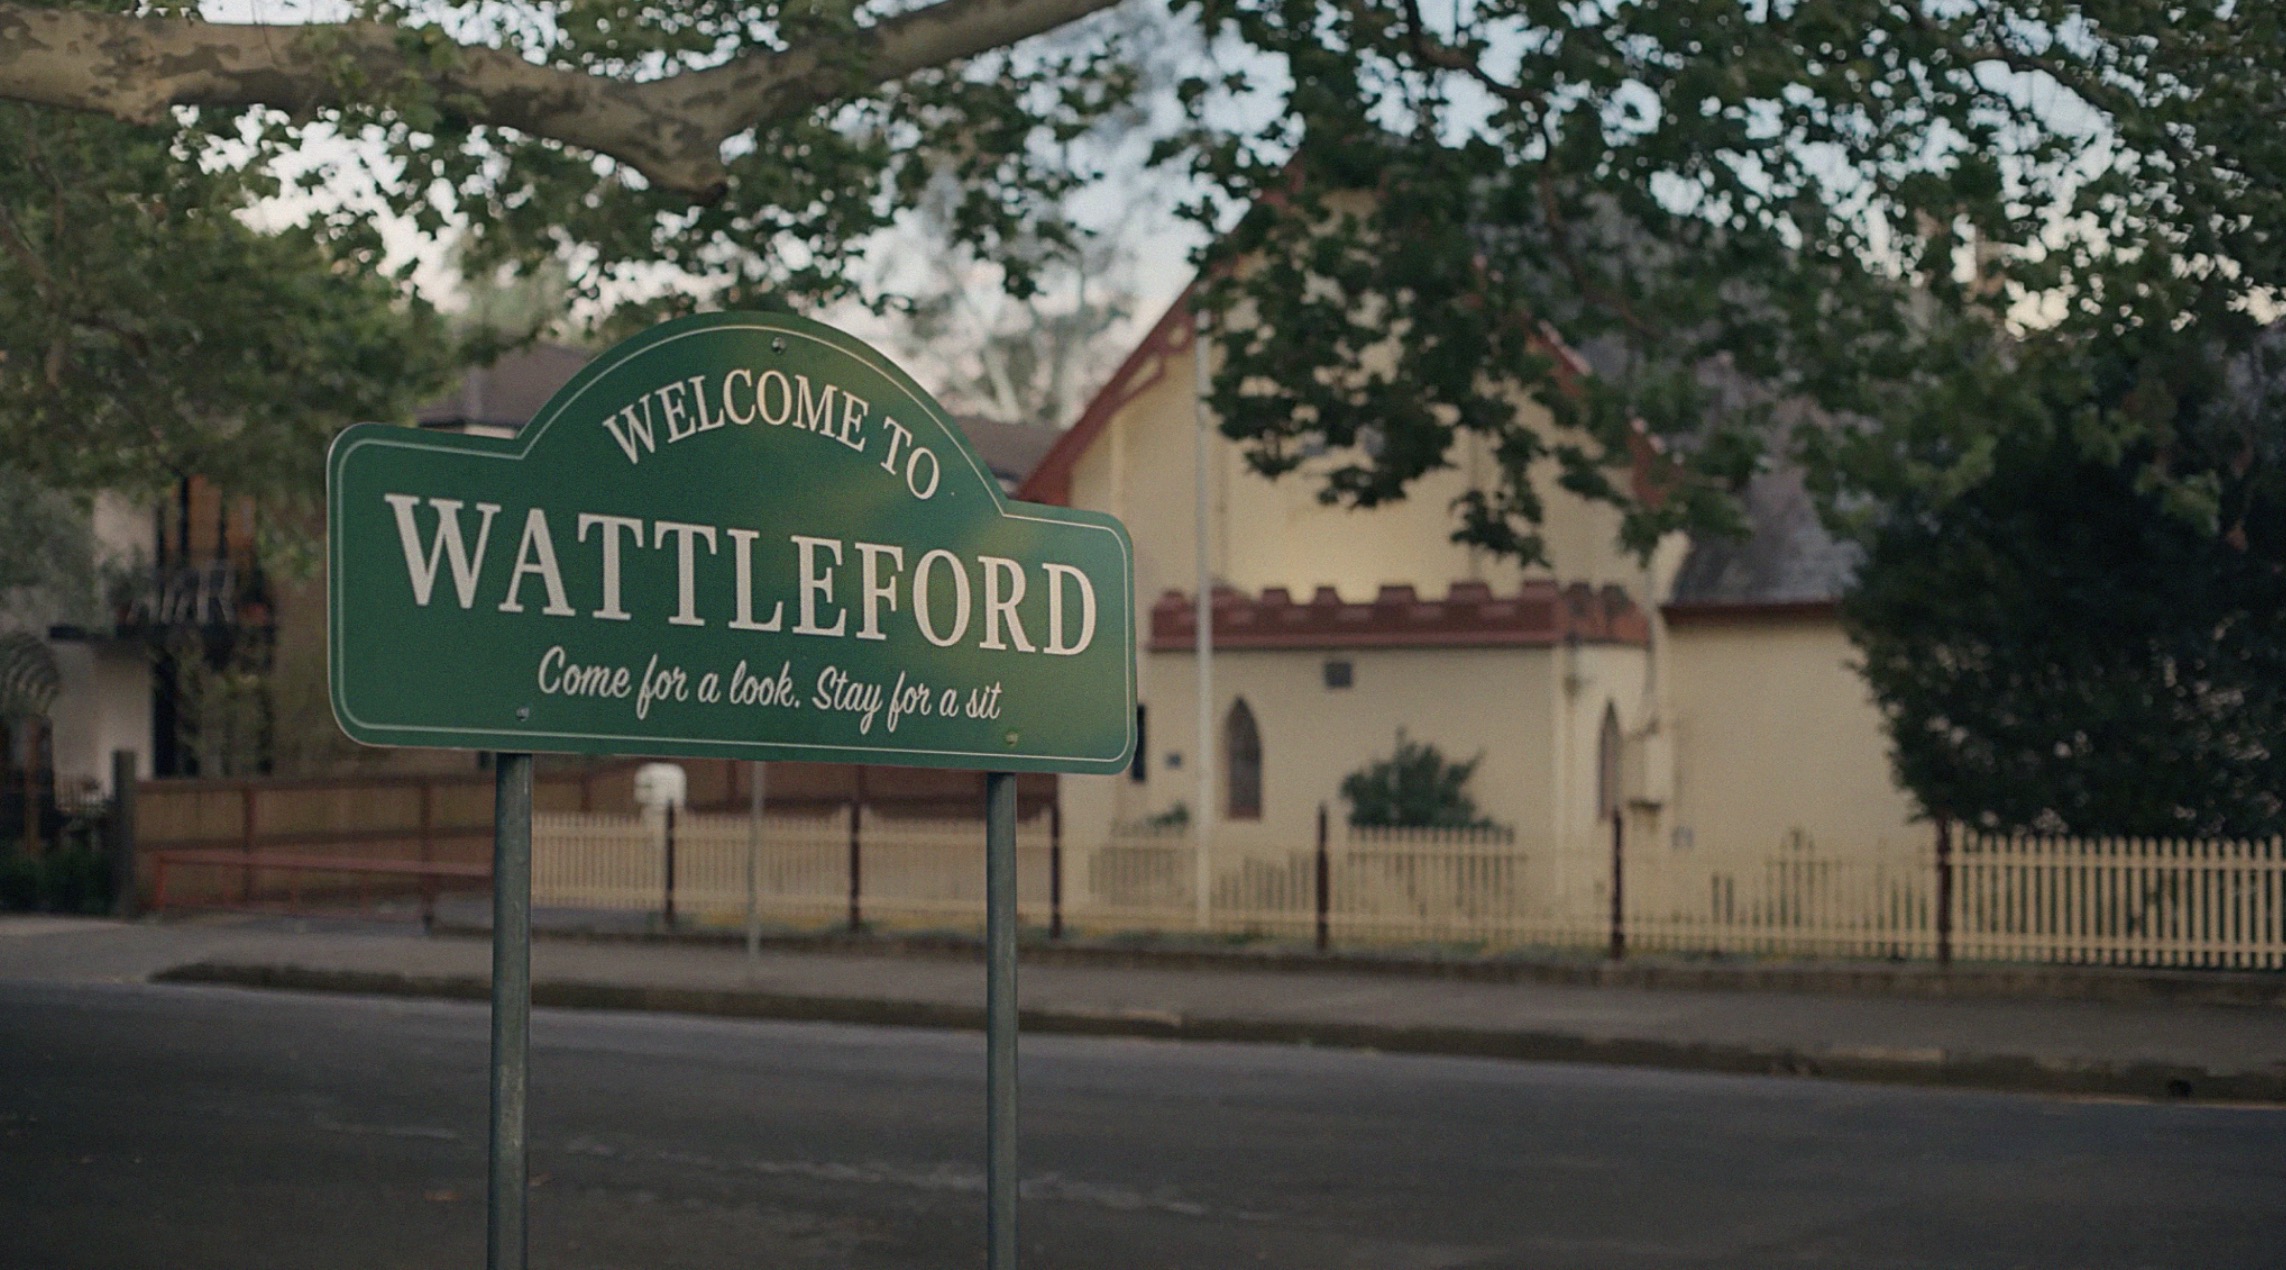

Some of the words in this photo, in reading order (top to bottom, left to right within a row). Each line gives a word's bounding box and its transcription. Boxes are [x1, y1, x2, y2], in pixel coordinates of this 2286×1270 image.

[602, 368, 869, 464] WELCOME
[881, 415, 940, 500] TO
[384, 493, 1097, 656] WATTLEFORD
[537, 645, 632, 698] Come
[635, 653, 690, 720] for
[697, 672, 722, 704] a
[728, 659, 801, 709] look.
[811, 665, 883, 735] Stay
[886, 670, 933, 733] for
[938, 687, 961, 718] a
[964, 679, 1004, 720] sit
